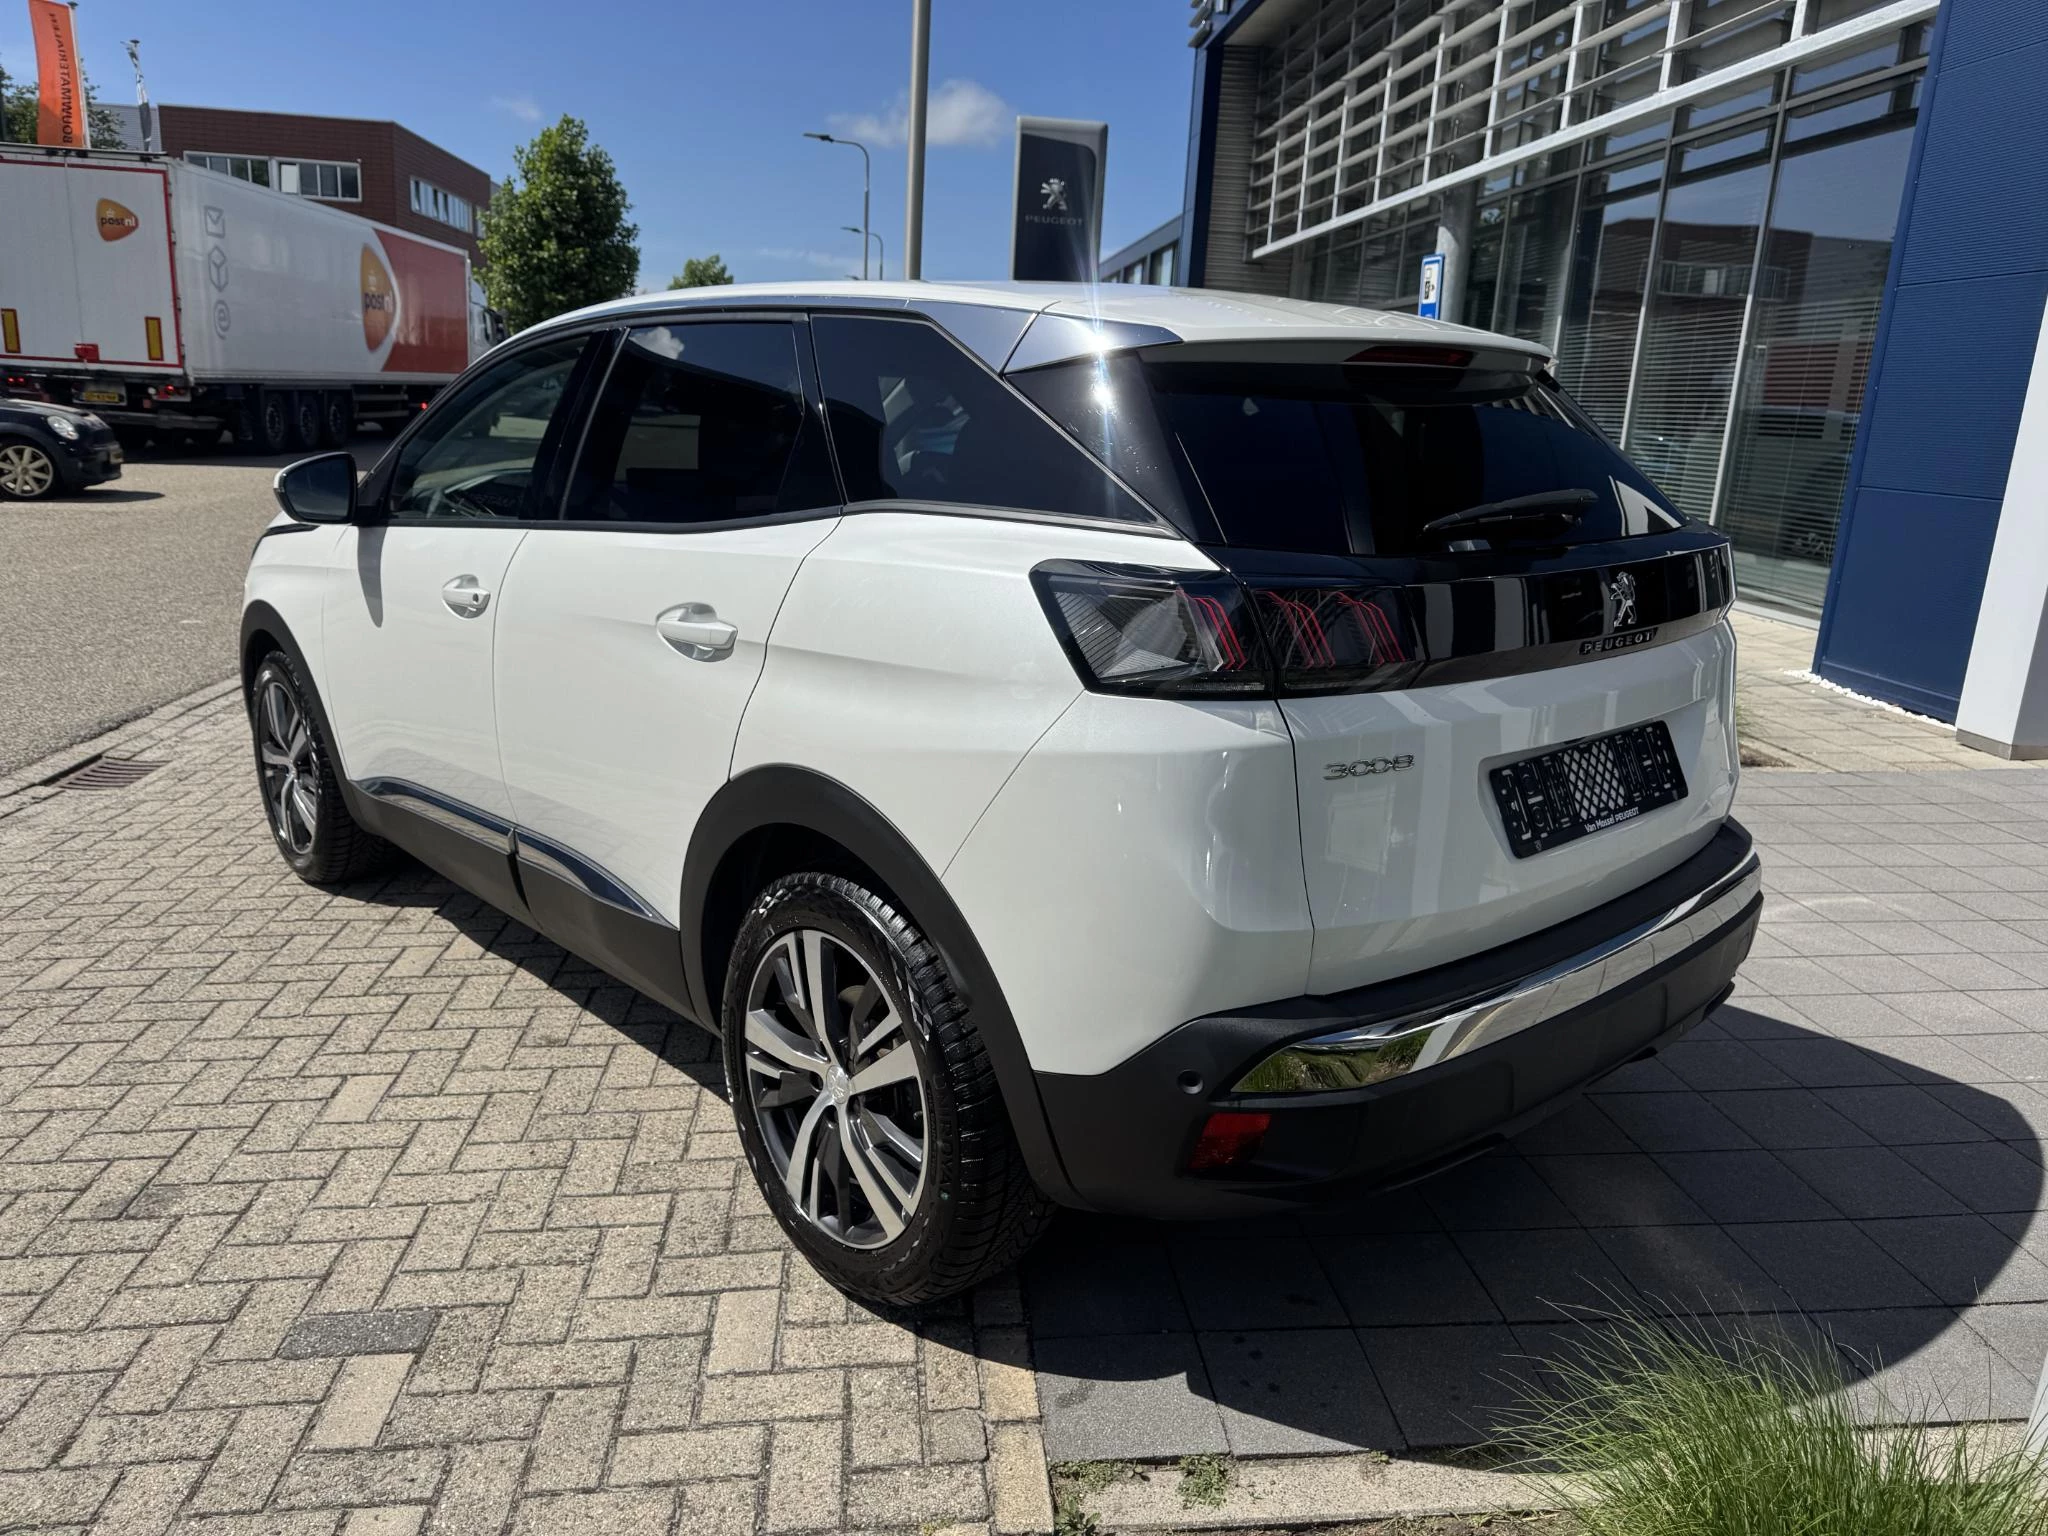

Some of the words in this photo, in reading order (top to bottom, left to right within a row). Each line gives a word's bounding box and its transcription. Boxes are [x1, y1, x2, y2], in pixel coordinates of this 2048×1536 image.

[1024, 215, 1083, 226] PEUGEOT
[1583, 630, 1654, 654] PEUGEOT
[1323, 754, 1416, 781] 3008
[1584, 823, 1597, 832] Van
[1595, 814, 1615, 829] Mossel
[1614, 806, 1640, 823] PEUGEOT
